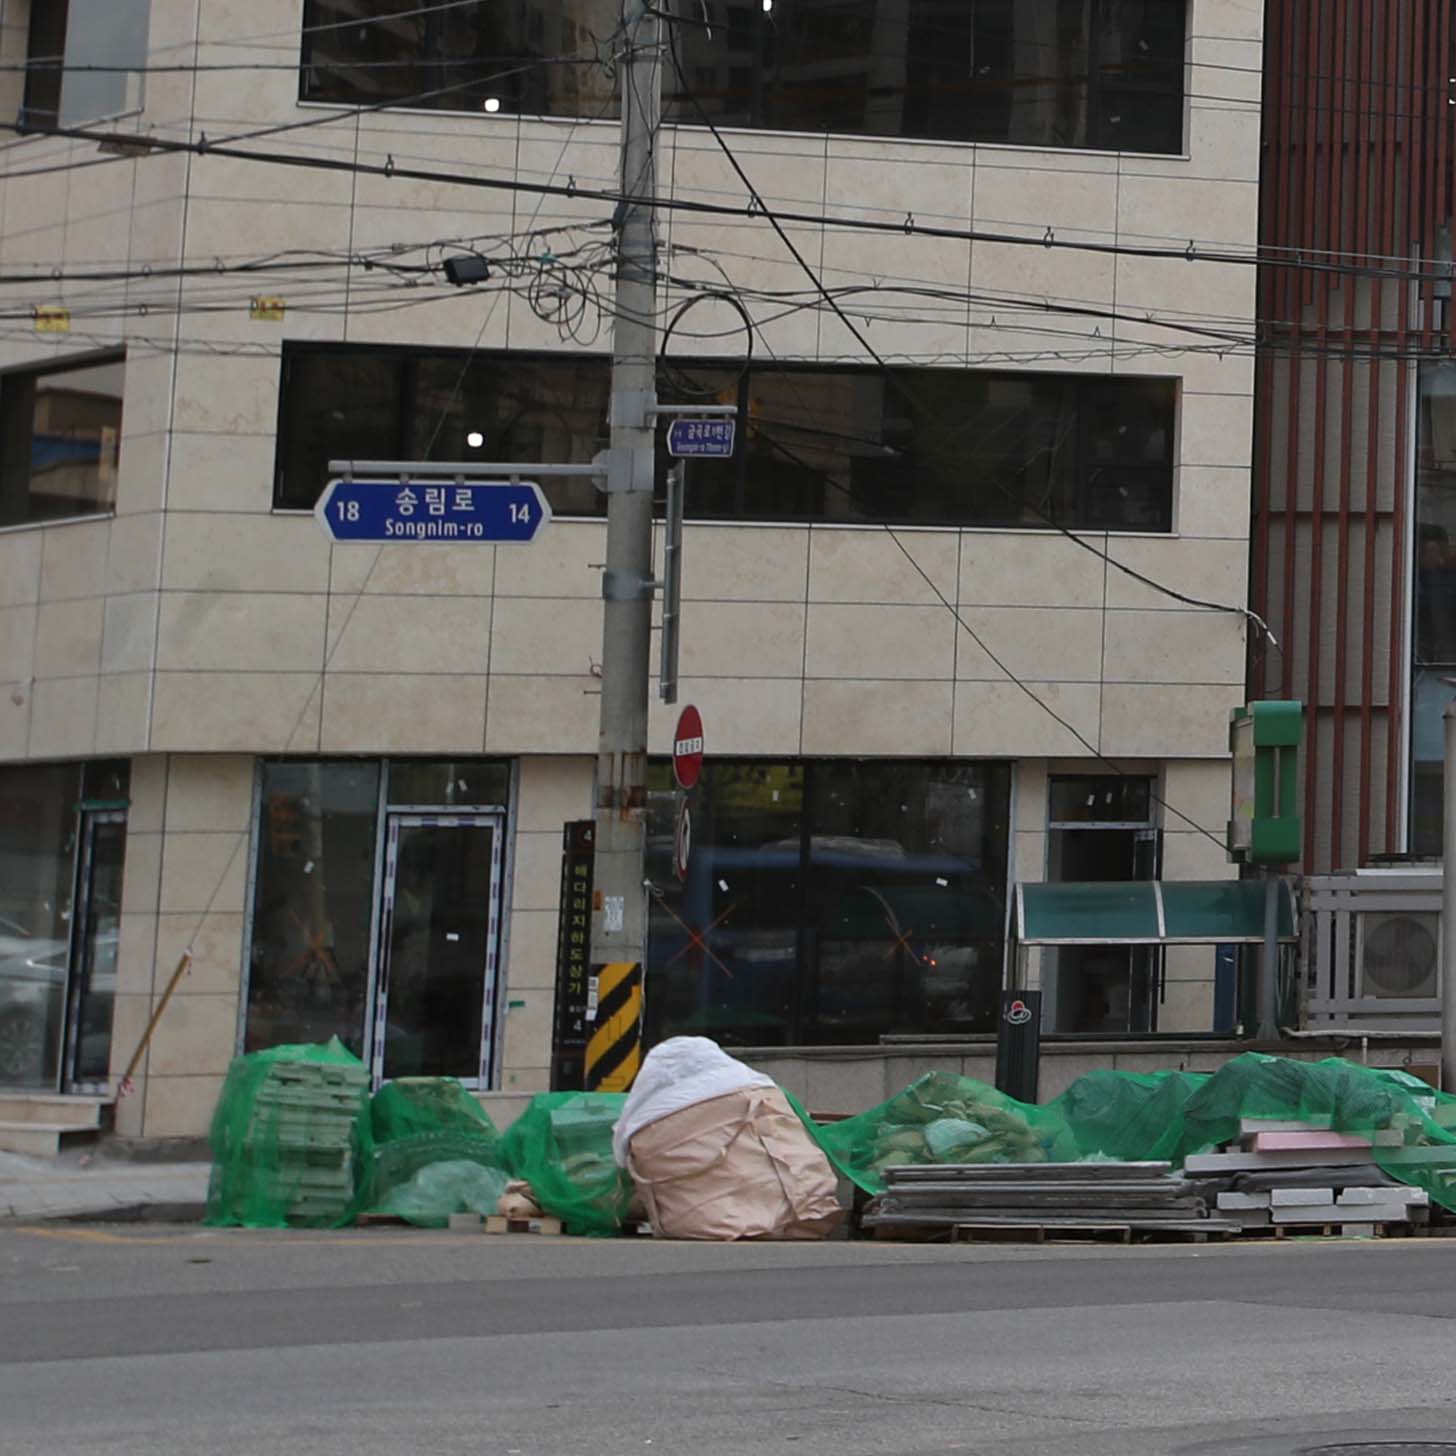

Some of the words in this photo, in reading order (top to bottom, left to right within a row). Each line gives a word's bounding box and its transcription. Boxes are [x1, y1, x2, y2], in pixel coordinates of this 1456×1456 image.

[336, 500, 361, 522] 18
[395, 487, 475, 517] 송림로
[509, 503, 531, 524] 14
[385, 518, 484, 539] Songnim-ro
[573, 1019, 582, 1032] 4
